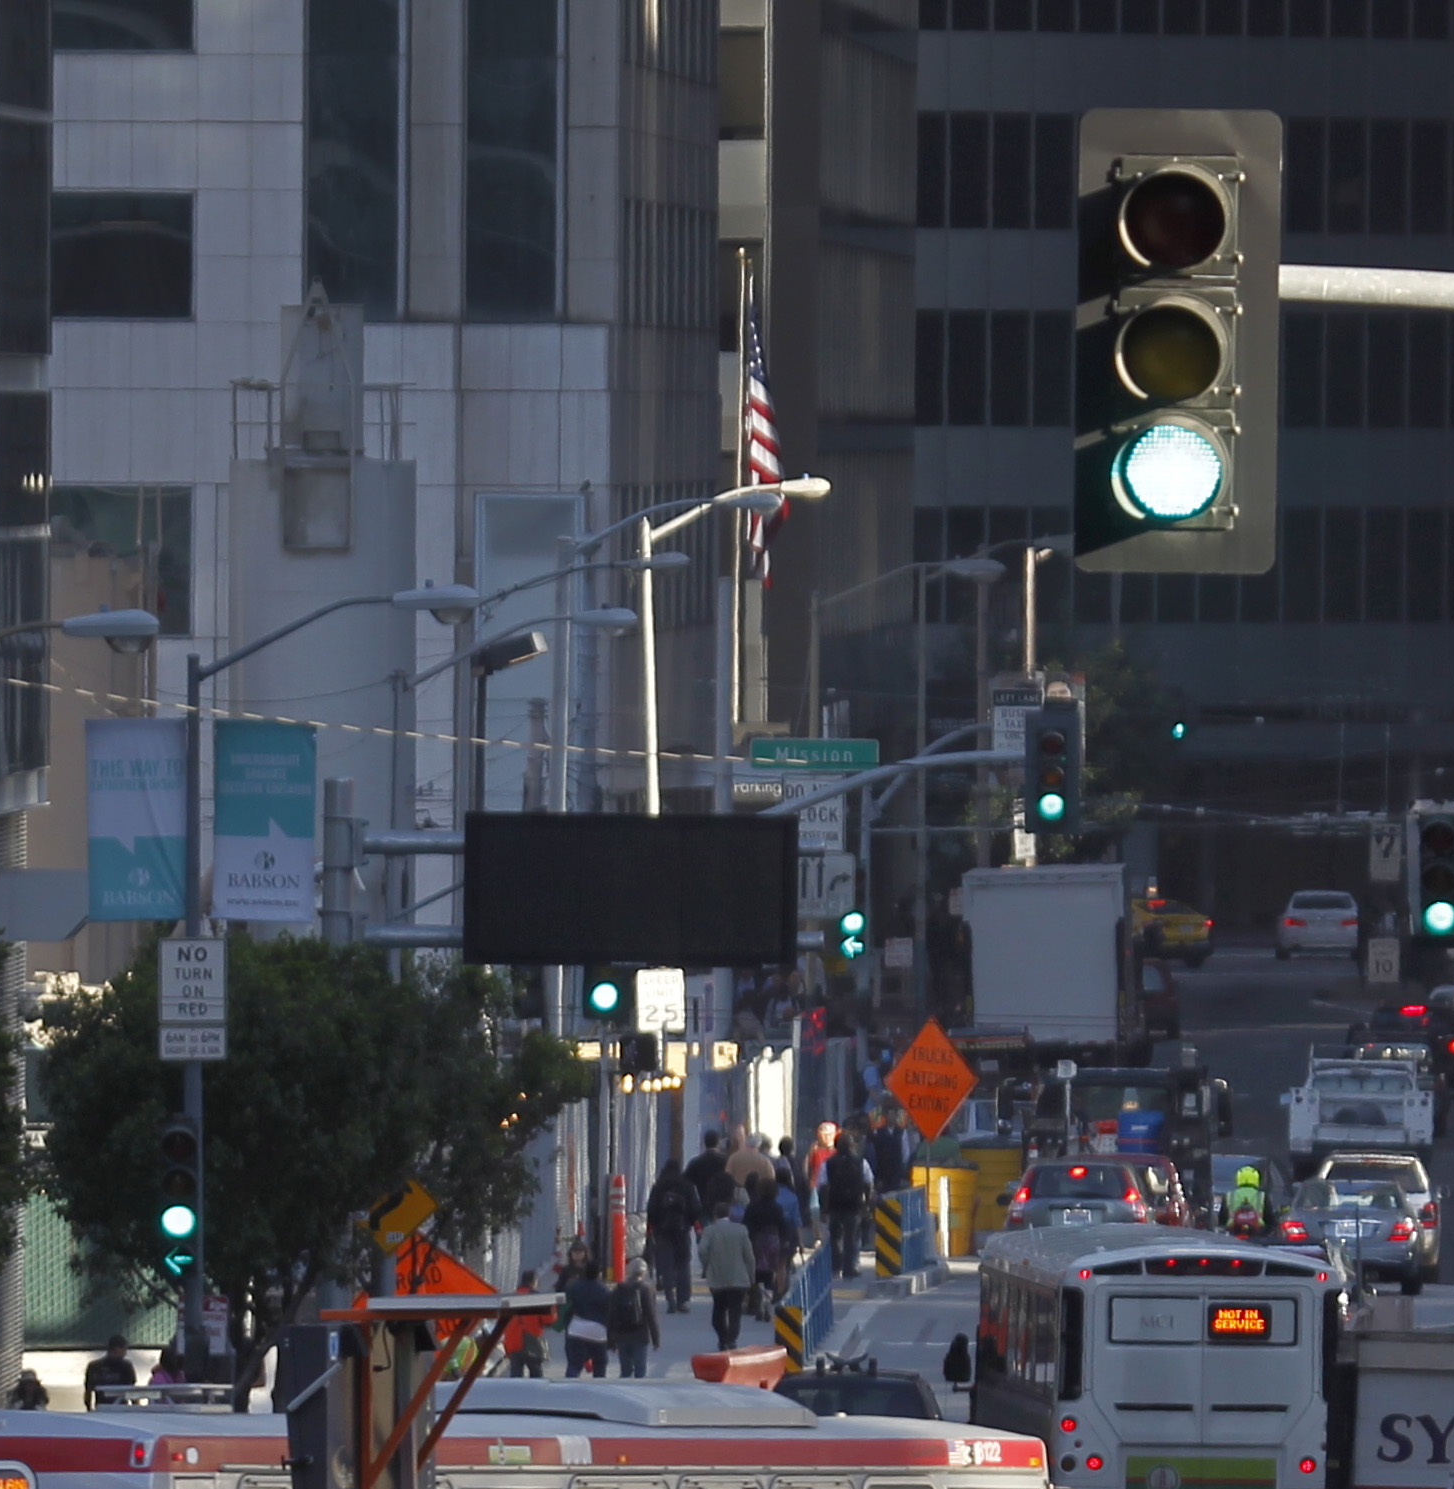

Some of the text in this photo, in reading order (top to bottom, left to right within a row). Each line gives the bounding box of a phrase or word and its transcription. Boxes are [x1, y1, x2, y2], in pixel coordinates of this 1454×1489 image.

[776, 747, 853, 763] Mission
[129, 758, 161, 777] WAY
[786, 784, 805, 799] DO
[227, 872, 301, 889] BABSON
[177, 946, 207, 962] NO
[174, 967, 213, 980] TURN
[1375, 959, 1393, 975] 10
[183, 984, 204, 998] ON
[178, 1003, 207, 1017] RED
[645, 1003, 679, 1022] 25
[1218, 1309, 1258, 1319] NOT IN
[1215, 1319, 1265, 1330] SERVICE
